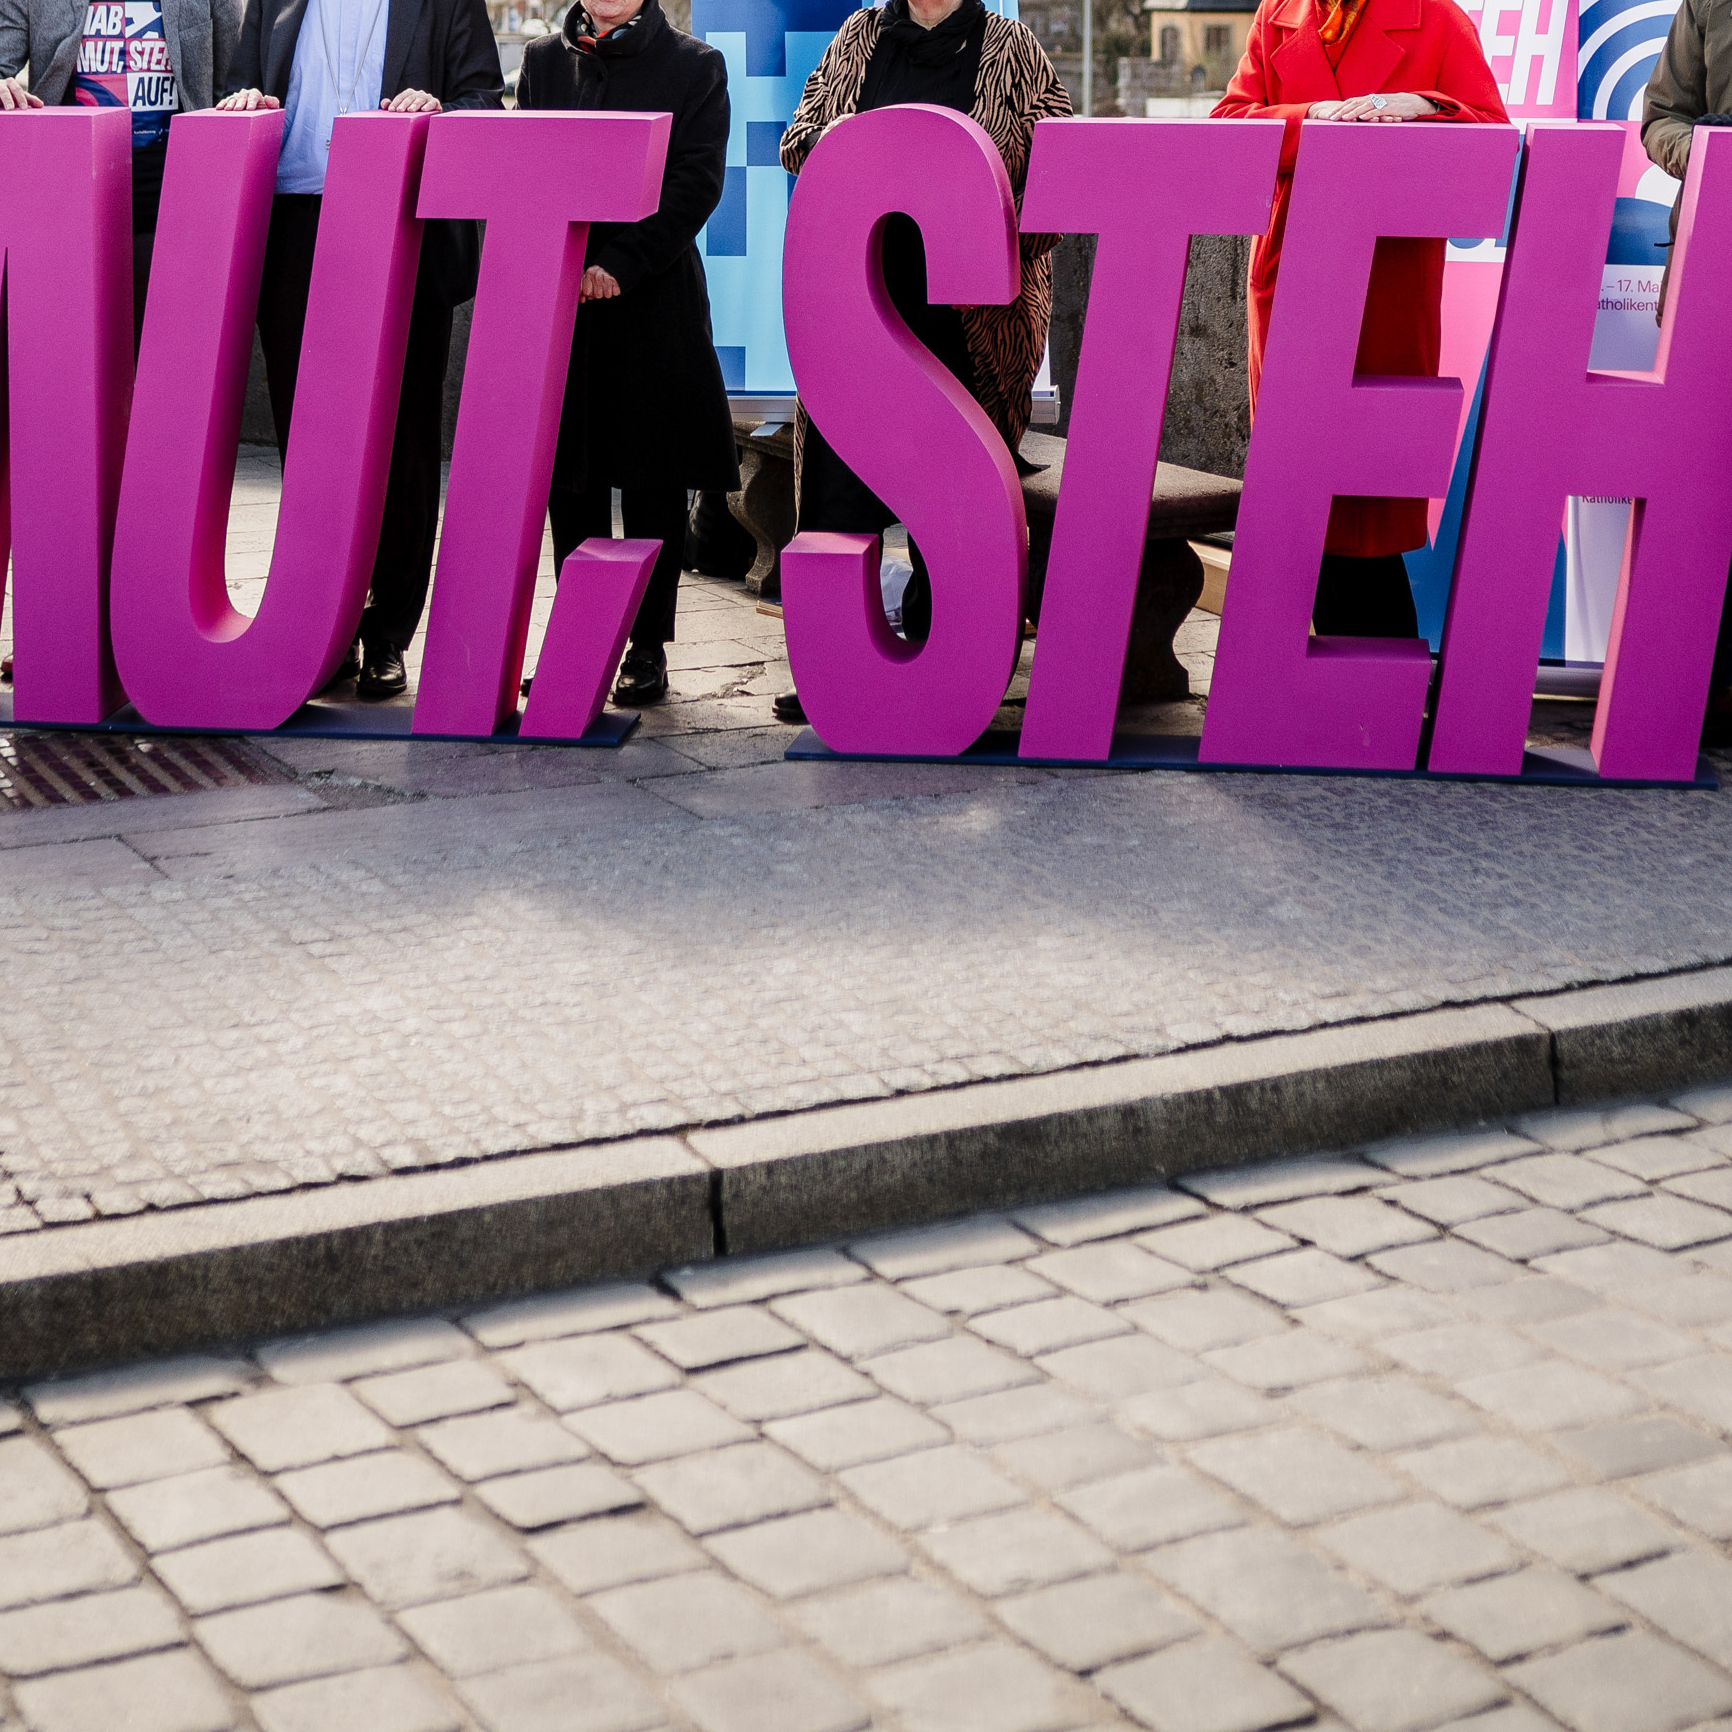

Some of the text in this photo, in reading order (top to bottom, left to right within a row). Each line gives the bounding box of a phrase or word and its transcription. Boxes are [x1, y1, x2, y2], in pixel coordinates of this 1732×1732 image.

[76, 40, 124, 73] MUT,
[132, 76, 174, 107] AUF!
[1638, 280, 1662, 293] Ma
[1598, 297, 1659, 311] tholikent
